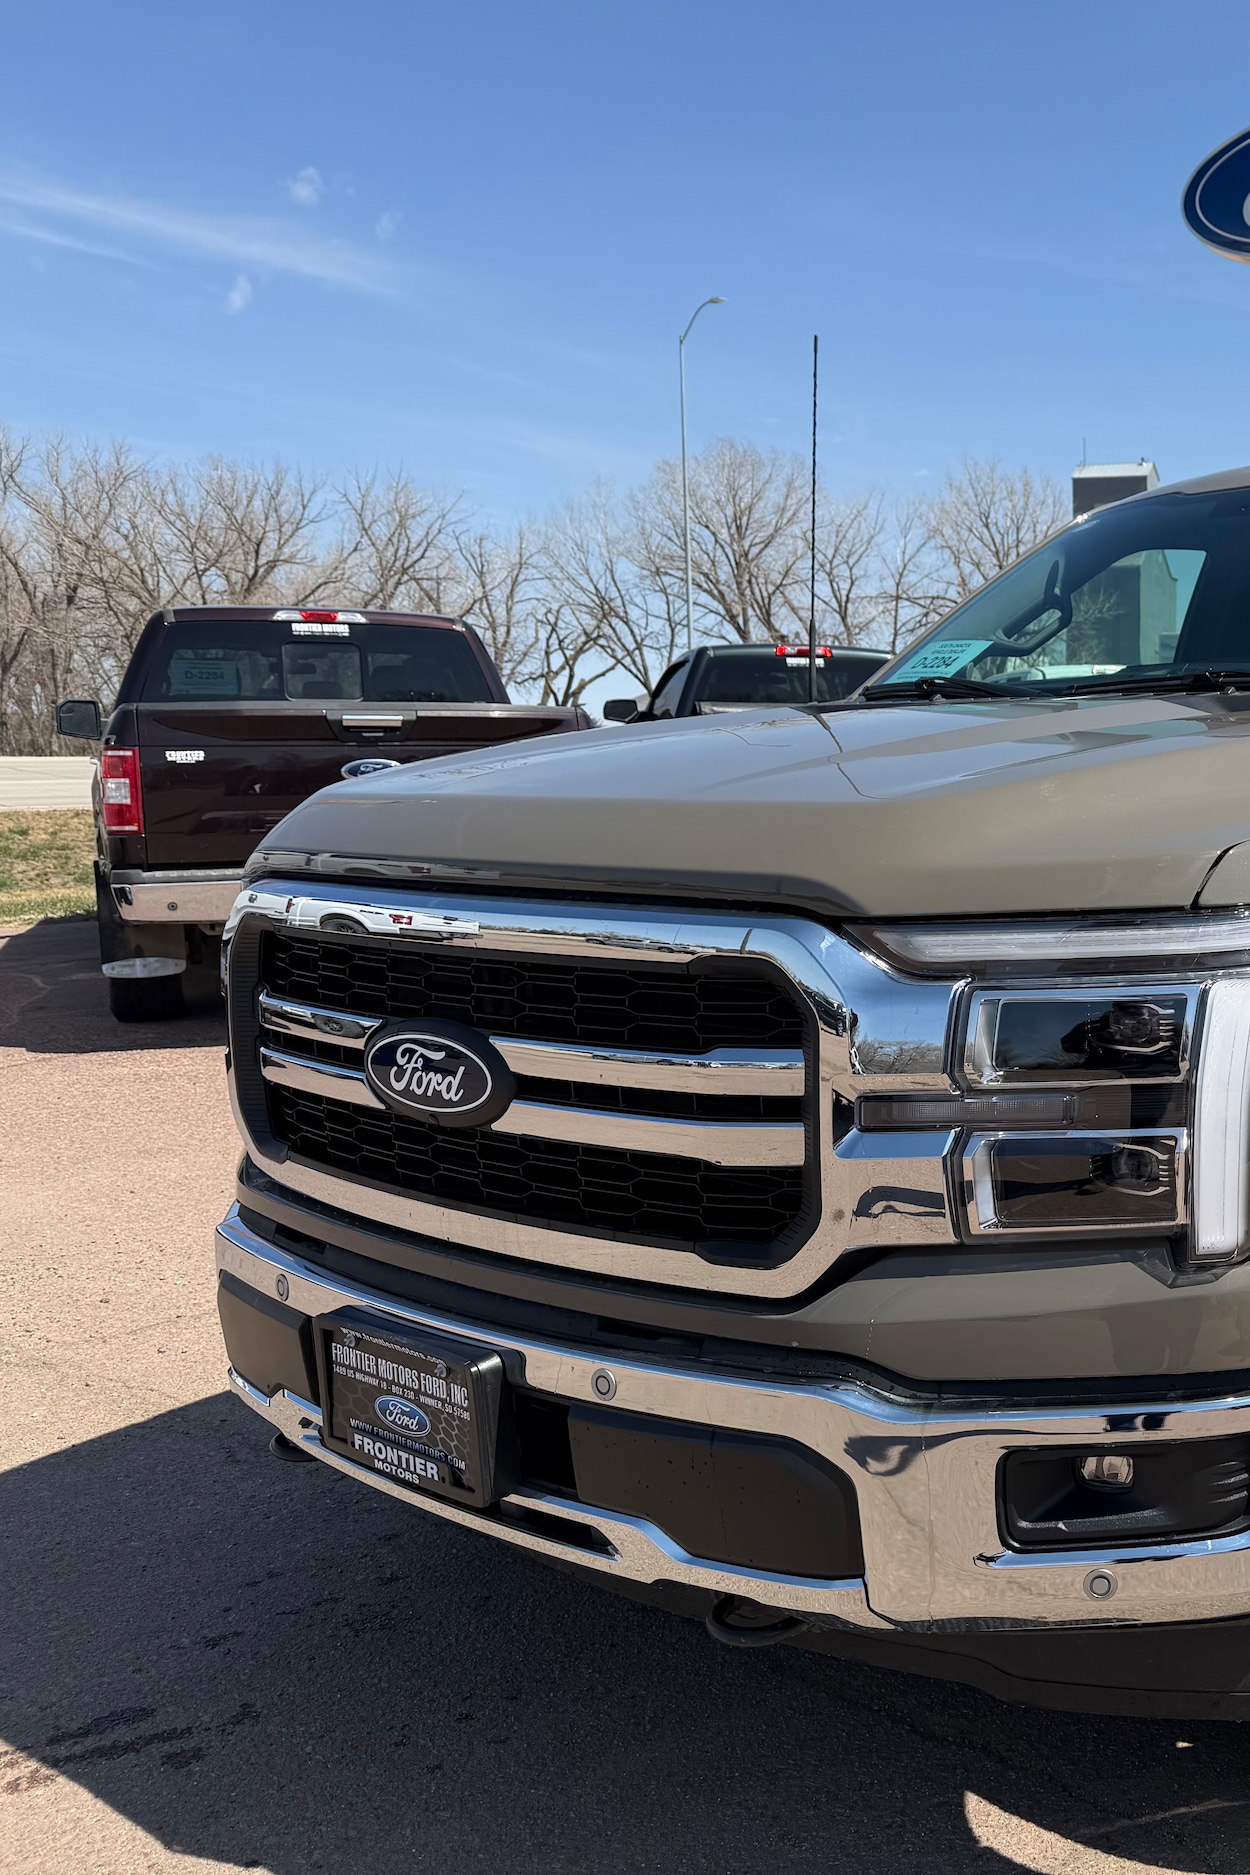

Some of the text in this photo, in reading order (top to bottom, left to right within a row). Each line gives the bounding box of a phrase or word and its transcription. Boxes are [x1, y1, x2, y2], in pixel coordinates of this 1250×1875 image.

[390, 1043, 465, 1102] Ford
[332, 1342, 468, 1407] FRONTIER MOTORS FORD, INC
[347, 1369, 355, 1378] US
[355, 1372, 379, 1387] HIGHWAY
[392, 1385, 403, 1396] BOX
[404, 1389, 415, 1400] 230
[386, 1400, 419, 1430] Ford
[349, 1418, 466, 1471] WWW.FRONTIERMOTORS.COM
[353, 1433, 439, 1481] FRONTIER
[374, 1459, 420, 1484] MOTORS
